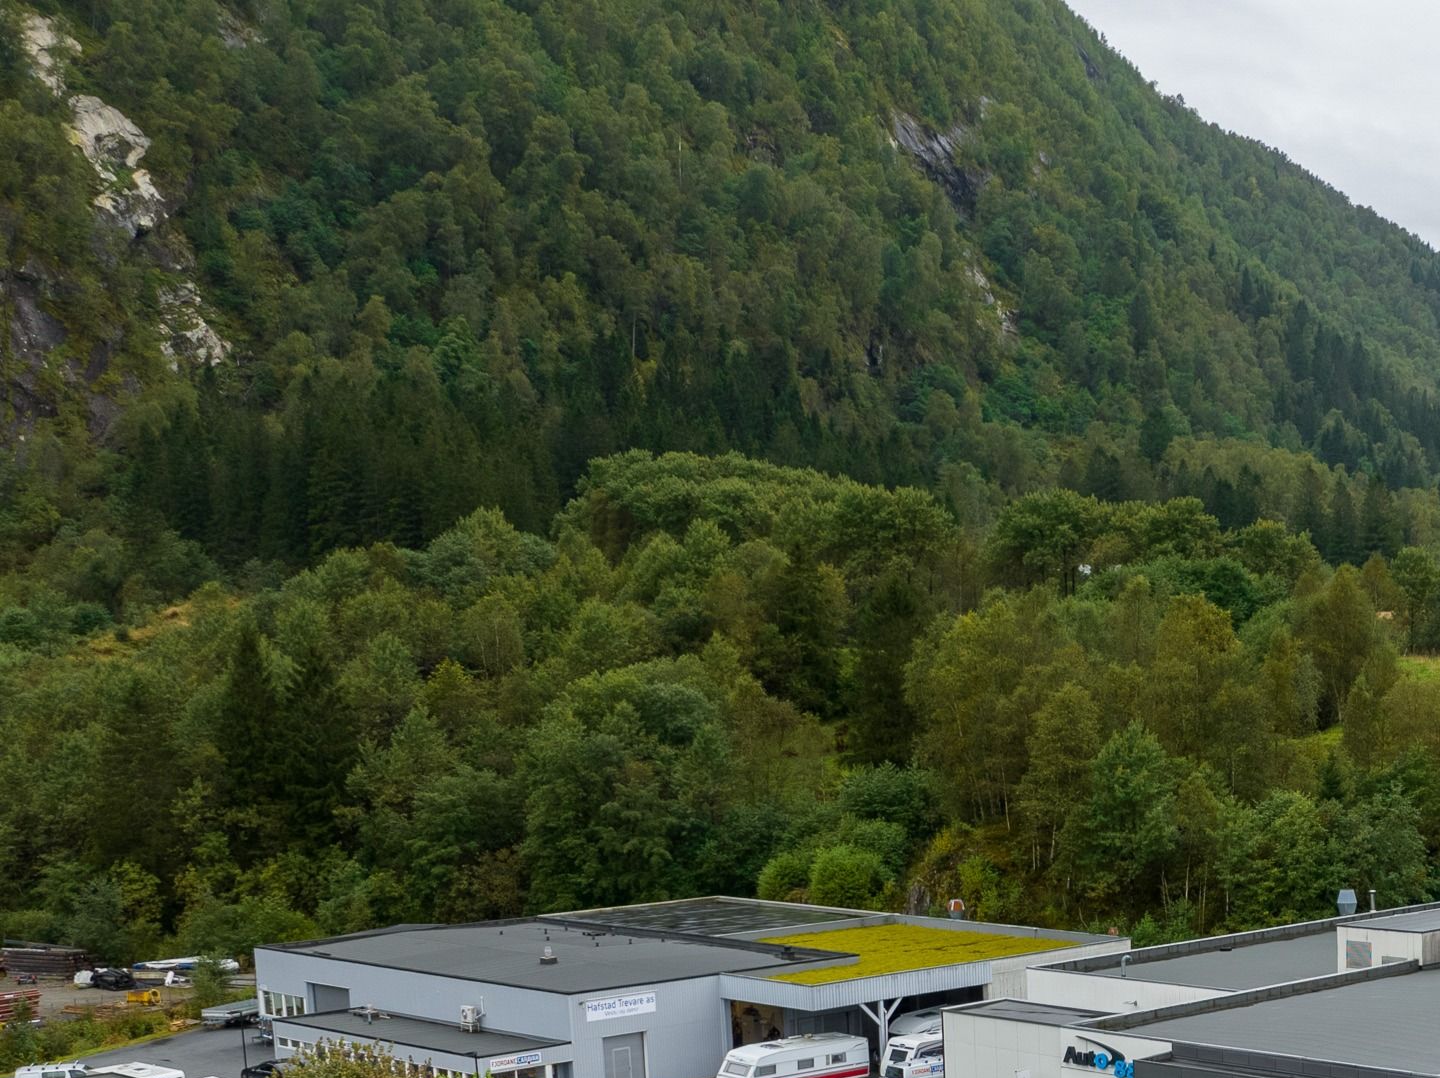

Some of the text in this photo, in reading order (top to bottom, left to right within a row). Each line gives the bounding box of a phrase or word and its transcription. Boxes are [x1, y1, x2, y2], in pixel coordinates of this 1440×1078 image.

[587, 1001, 616, 1012] Hafstad
[618, 997, 644, 1008] Trevare
[1063, 1046, 1108, 1070] Auto
